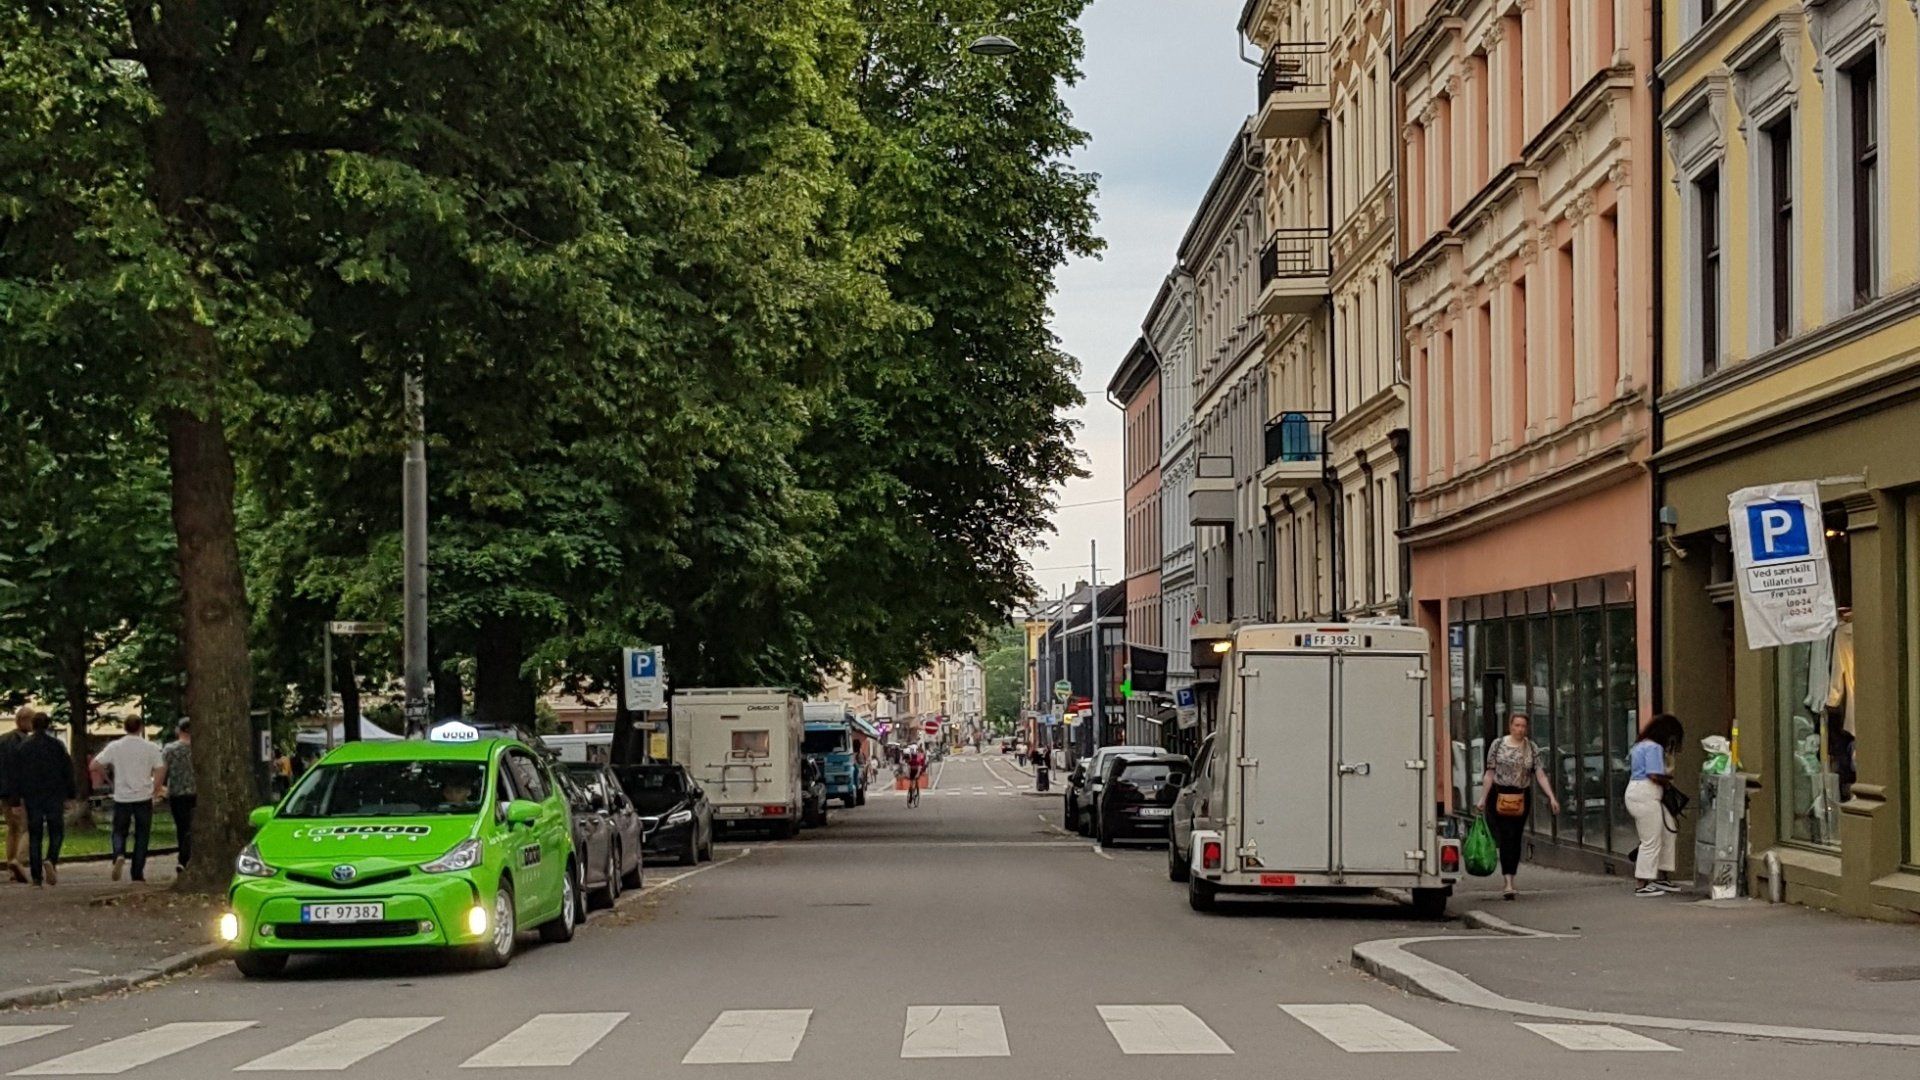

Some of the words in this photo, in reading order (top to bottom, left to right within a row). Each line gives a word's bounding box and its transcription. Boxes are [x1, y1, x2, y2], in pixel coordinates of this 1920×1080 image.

[1761, 509, 1792, 553] P
[1753, 569, 1771, 578] Ved
[1774, 565, 1811, 576] særskilt
[1763, 577, 1803, 587] tillatelse
[1314, 635, 1325, 645] FF
[1331, 635, 1356, 645] 3952
[637, 654, 651, 675] P
[1180, 690, 1190, 705] P
[314, 906, 330, 919] CF
[336, 906, 378, 918] 97382
